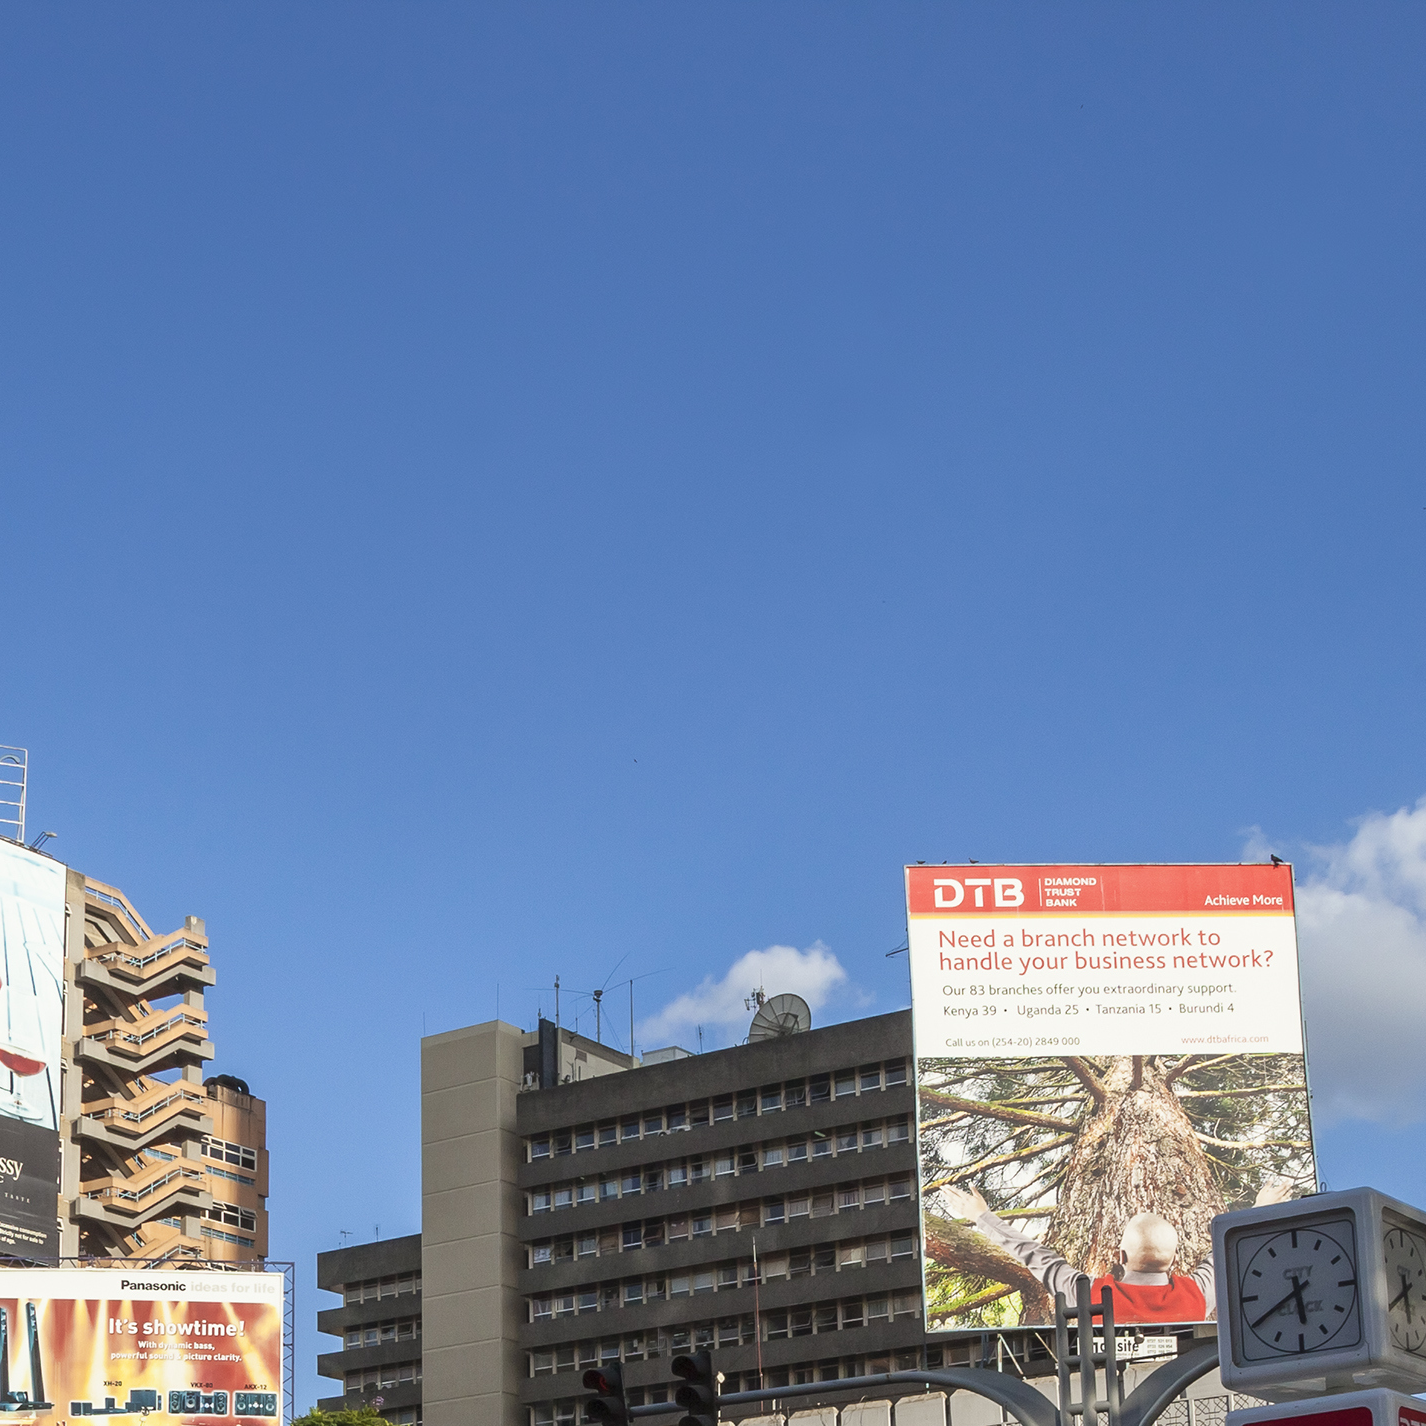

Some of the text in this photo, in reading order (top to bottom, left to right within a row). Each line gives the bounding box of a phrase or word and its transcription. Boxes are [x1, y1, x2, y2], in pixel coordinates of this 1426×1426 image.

[1044, 877, 1097, 887] DIAMOND
[934, 878, 1025, 908] DTB
[1045, 888, 1081, 897] TRUST
[1045, 898, 1078, 907] BANK
[1204, 894, 1283, 906] Achieve More
[939, 928, 1221, 949] Need a branch network to
[939, 949, 1274, 975] handle your business network?
[943, 983, 1237, 998] Our 83 branches offer you extraordinary support.
[943, 1003, 1235, 1019] Kenya 39 Uganda 25 Tanzania 15 Burundi 4
[945, 1036, 1080, 1049] Call us on (254-20) 2849 000
[1181, 1034, 1269, 1046] www.dtbafrica.com
[4, 1192, 31, 1204] TASTE
[1282, 1265, 1313, 1280] CITY
[121, 1279, 275, 1294] Panasonic ideas for life
[1277, 1300, 1323, 1317] CLCK
[108, 1318, 246, 1336] It's showtime!
[138, 1340, 215, 1351] With dynamic bass,
[110, 1352, 148, 1361] powerful
[149, 1352, 174, 1360] sound
[184, 1352, 212, 1362] picture
[214, 1353, 243, 1363] clarity.
